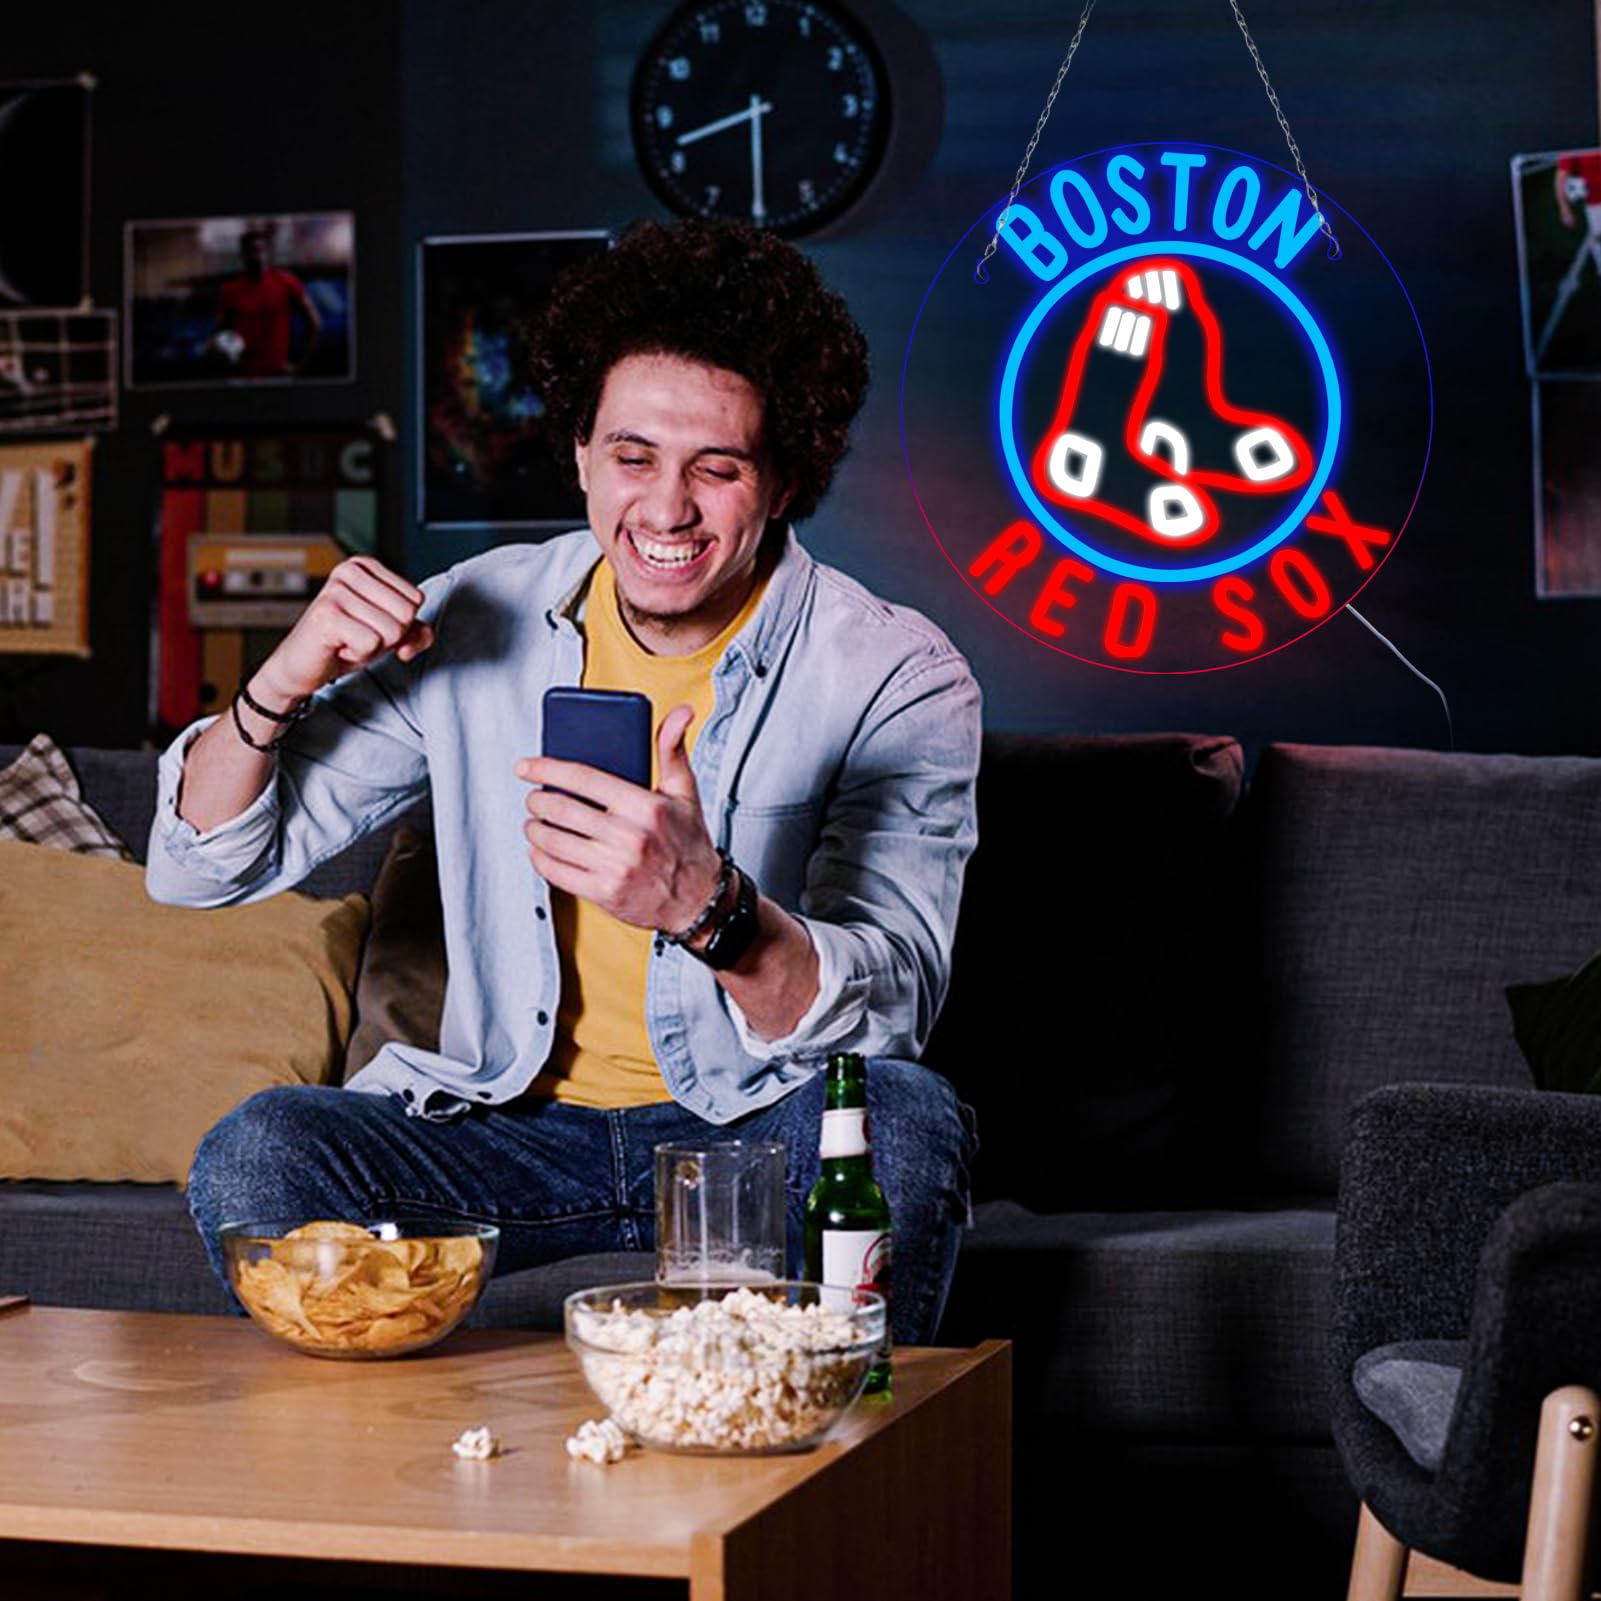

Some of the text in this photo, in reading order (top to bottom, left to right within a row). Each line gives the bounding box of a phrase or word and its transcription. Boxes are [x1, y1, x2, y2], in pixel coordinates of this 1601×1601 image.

[995, 152, 1325, 282] BOSTON
[162, 440, 375, 483] MUSIC
[969, 490, 1391, 658] RED SOX
